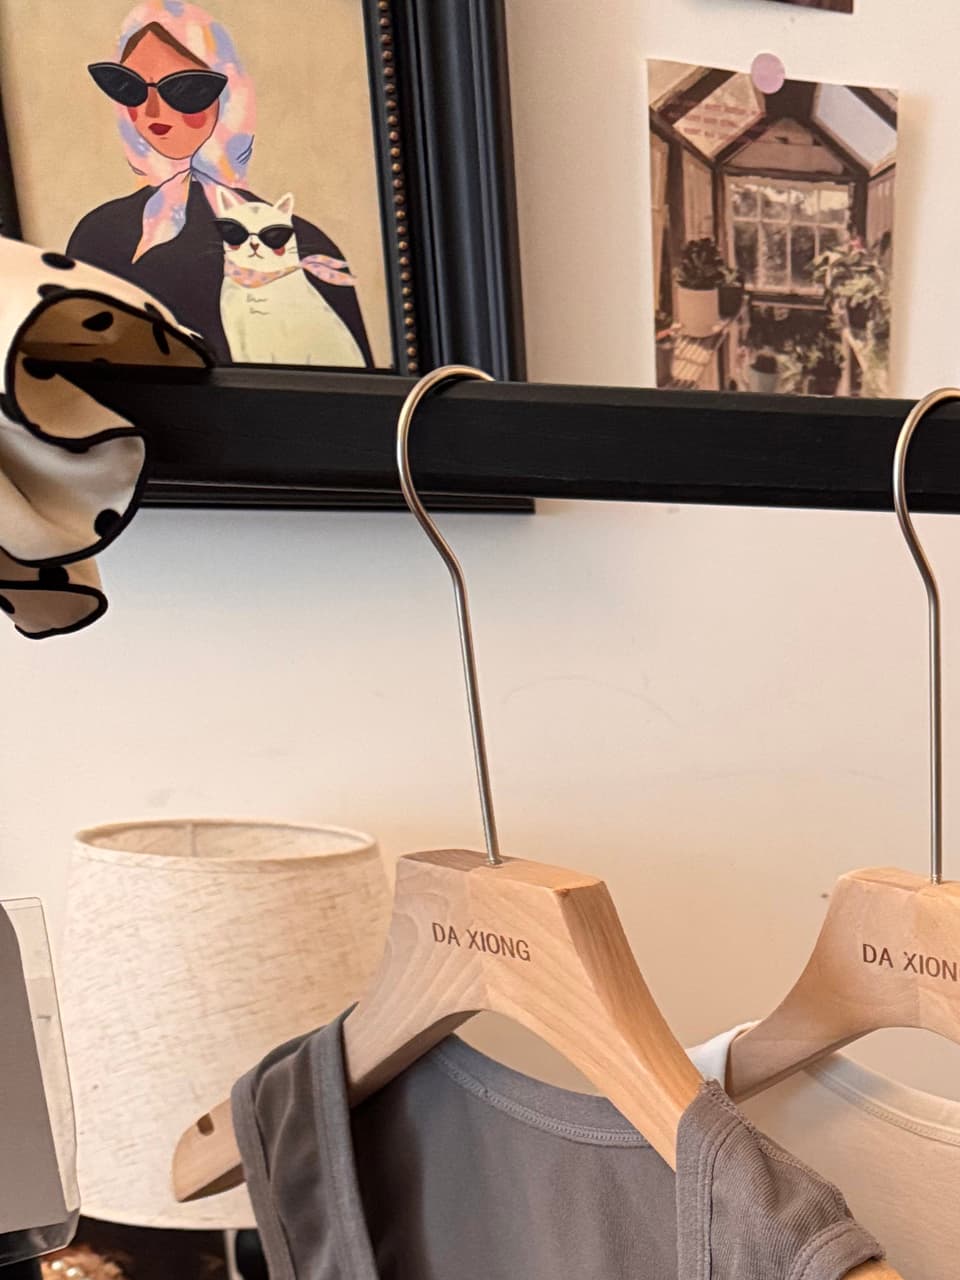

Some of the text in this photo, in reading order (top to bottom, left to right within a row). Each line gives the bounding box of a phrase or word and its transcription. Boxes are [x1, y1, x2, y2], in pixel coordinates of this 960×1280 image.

[432, 922, 531, 961] DA XIONG
[862, 943, 894, 968] DA
